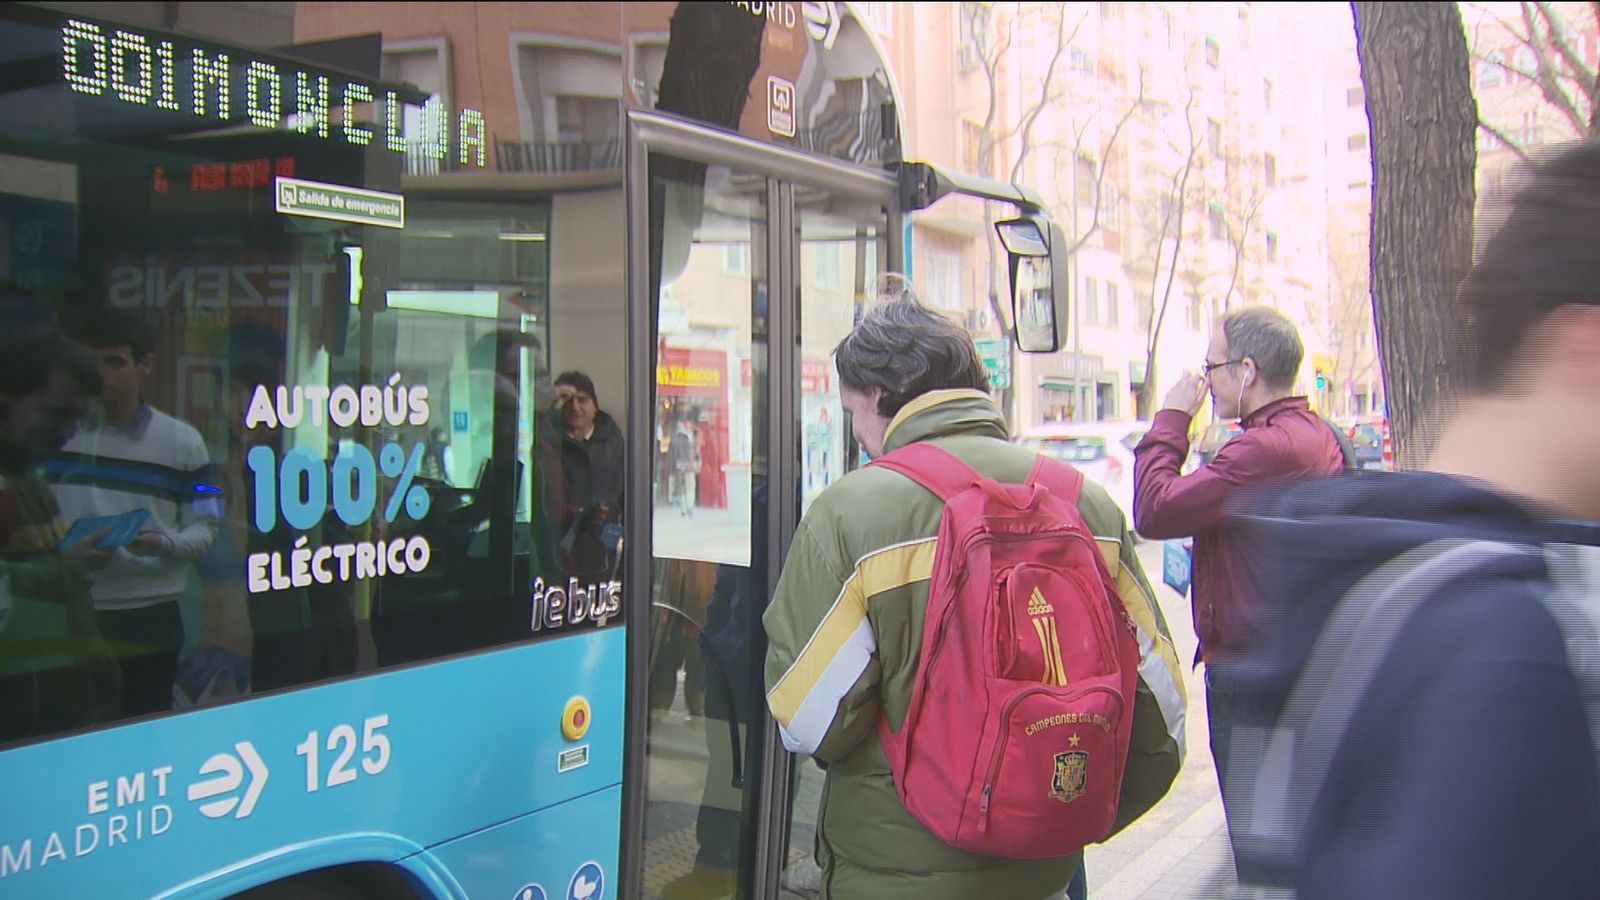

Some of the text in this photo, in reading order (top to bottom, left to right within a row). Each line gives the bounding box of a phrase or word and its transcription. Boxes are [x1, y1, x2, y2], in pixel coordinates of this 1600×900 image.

[726, 1, 796, 29] DRID
[192, 48, 486, 167] MONCLOA
[298, 190, 399, 216] Salida de emergencia
[245, 372, 430, 428] AUTOBÚS
[247, 442, 431, 533] 100%
[247, 536, 431, 593] ELÉCTRICO
[1025, 713, 1077, 736] CAMPEONES
[296, 714, 391, 793] 125
[87, 766, 173, 815] EMT
[1, 804, 173, 877] MADRID
